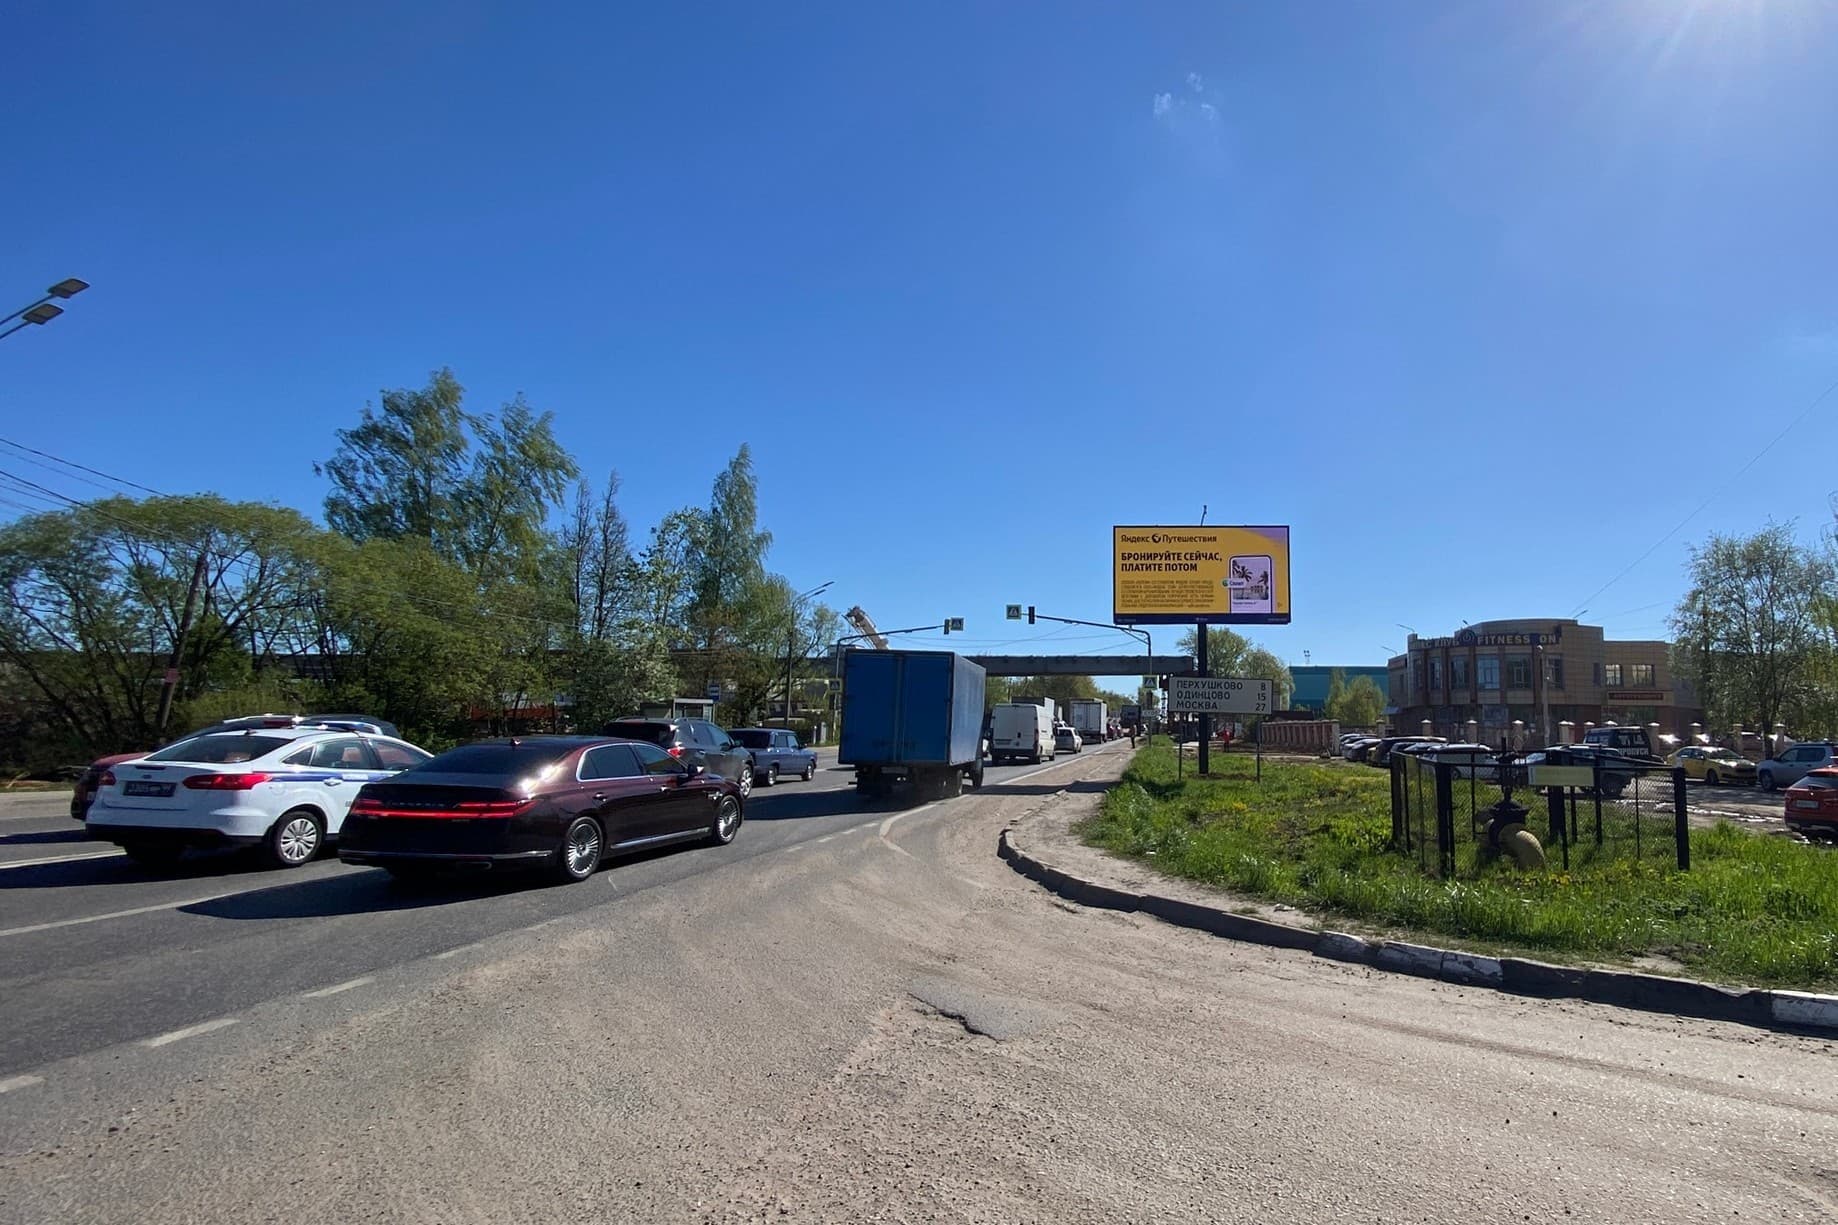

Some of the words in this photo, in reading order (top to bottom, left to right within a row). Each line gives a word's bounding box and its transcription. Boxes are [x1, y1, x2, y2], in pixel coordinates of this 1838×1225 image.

[1121, 534, 1150, 543] Яндекс
[1162, 534, 1217, 544] Путешествия
[1121, 551, 1182, 561] БРОНИРУЙТЕ
[1183, 551, 1222, 562] СЕЙЧАС,
[1121, 563, 1163, 572] ПЛАТИТЕ
[1164, 563, 1198, 572] ПОТОМ
[1477, 635, 1531, 645] FITNESS
[1539, 634, 1557, 644] ON
[1176, 681, 1243, 690] ПЕРХУШКОВО
[1176, 690, 1231, 701] ОДИНЦОВО
[1257, 692, 1267, 702] 15
[1176, 700, 1218, 710] МОСКВА
[1255, 702, 1267, 712] 27
